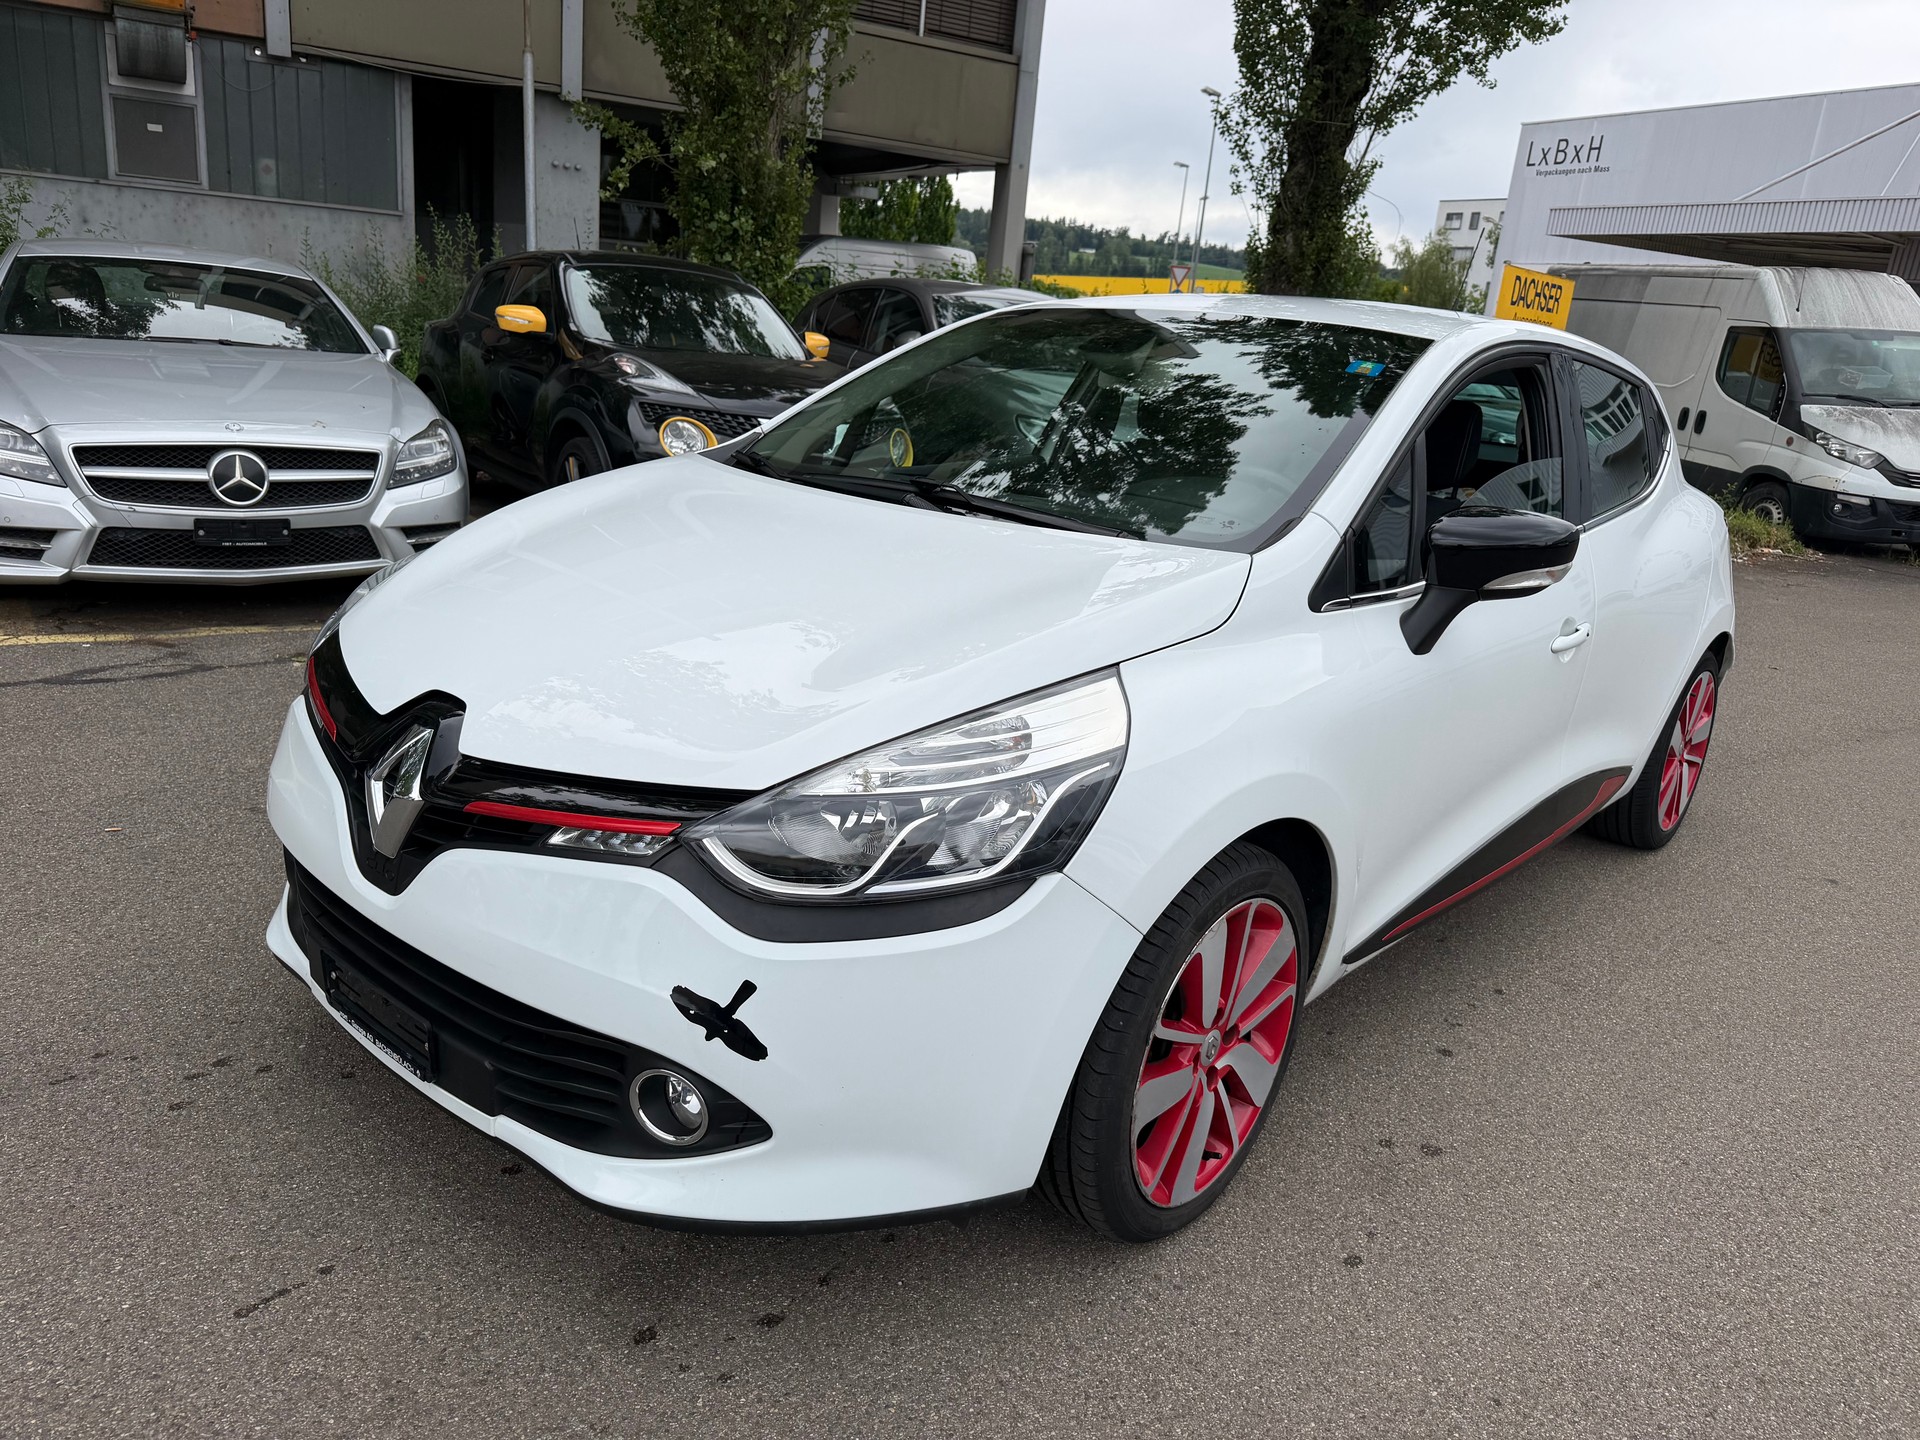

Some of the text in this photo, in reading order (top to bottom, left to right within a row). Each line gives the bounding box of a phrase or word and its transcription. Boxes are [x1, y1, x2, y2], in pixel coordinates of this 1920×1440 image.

[1526, 135, 1604, 167] LxBxH
[1536, 165, 1610, 177] Verpackungen nach Mass
[1510, 275, 1563, 315] DACHSER
[351, 1019, 366, 1037] Garage
[367, 1032, 373, 1042] AG
